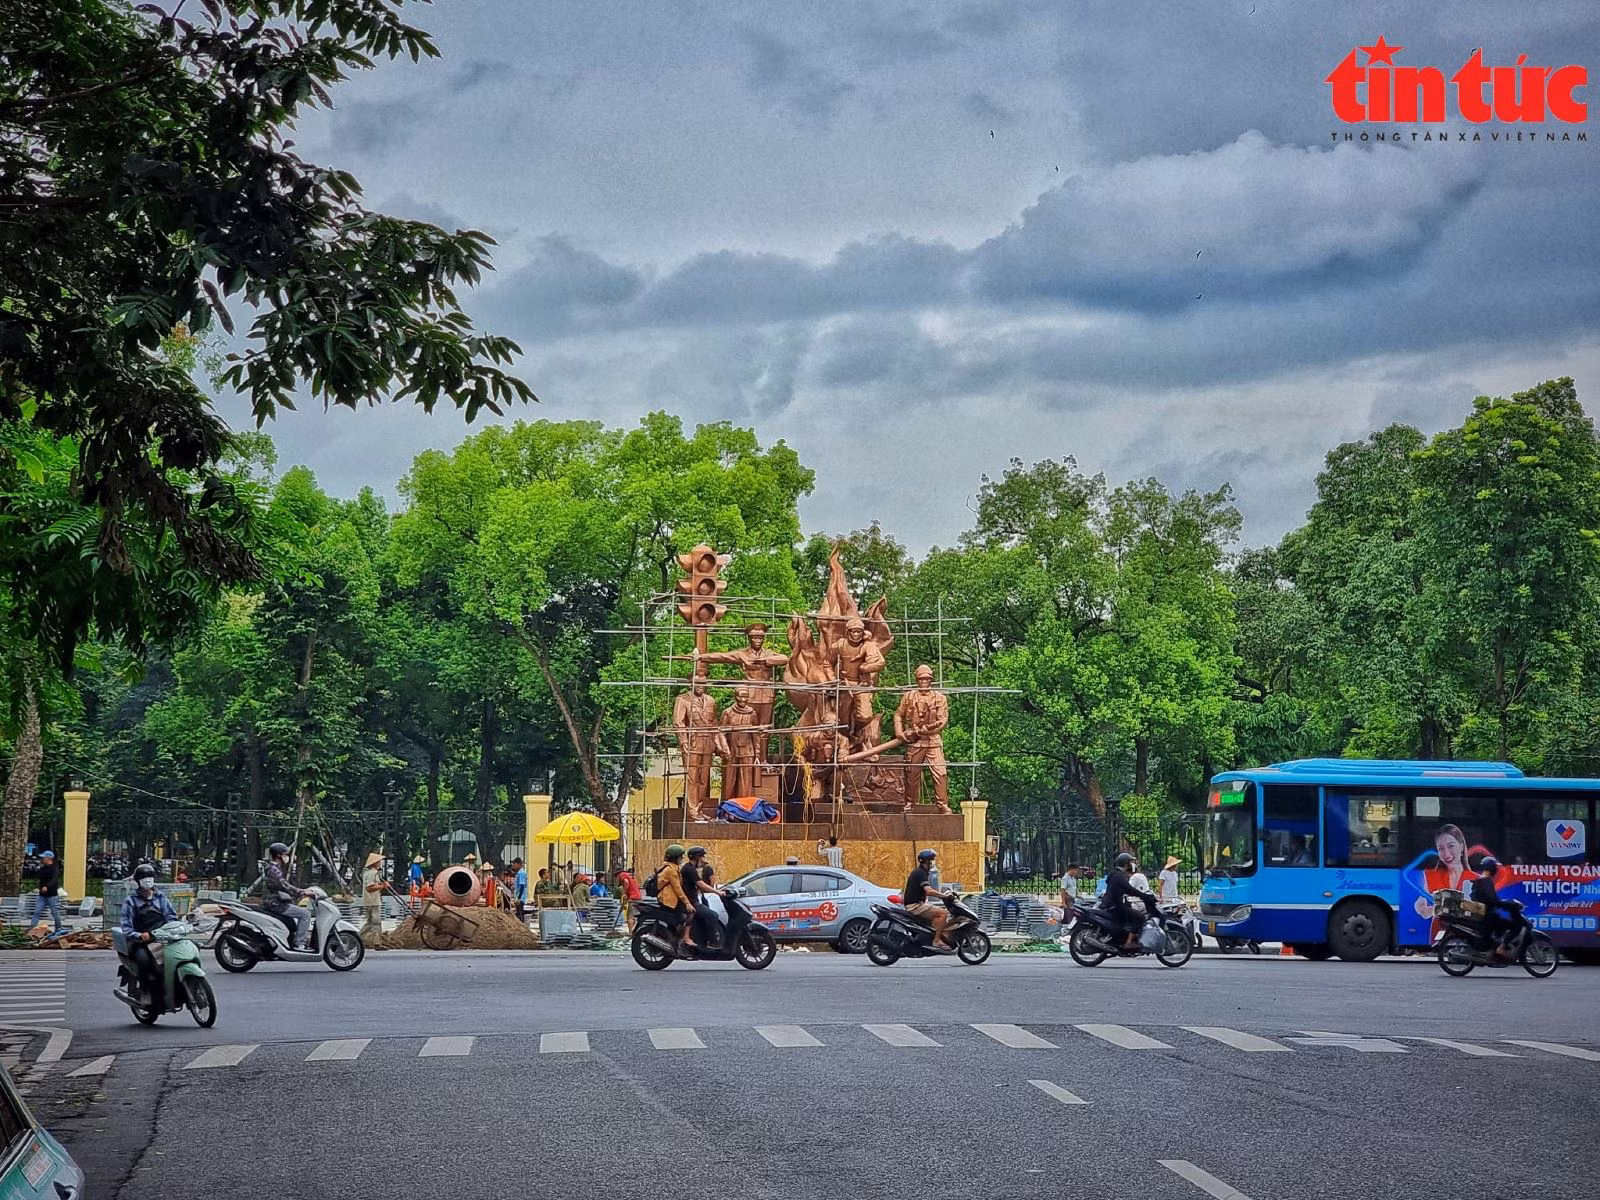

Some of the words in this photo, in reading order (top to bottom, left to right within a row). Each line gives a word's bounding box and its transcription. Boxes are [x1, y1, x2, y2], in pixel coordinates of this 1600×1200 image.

[1510, 864, 1559, 876] THANH
[1561, 862, 1600, 877] TOÁN
[1522, 879, 1553, 897] TIỆN
[1556, 879, 1581, 894] ÍCH
